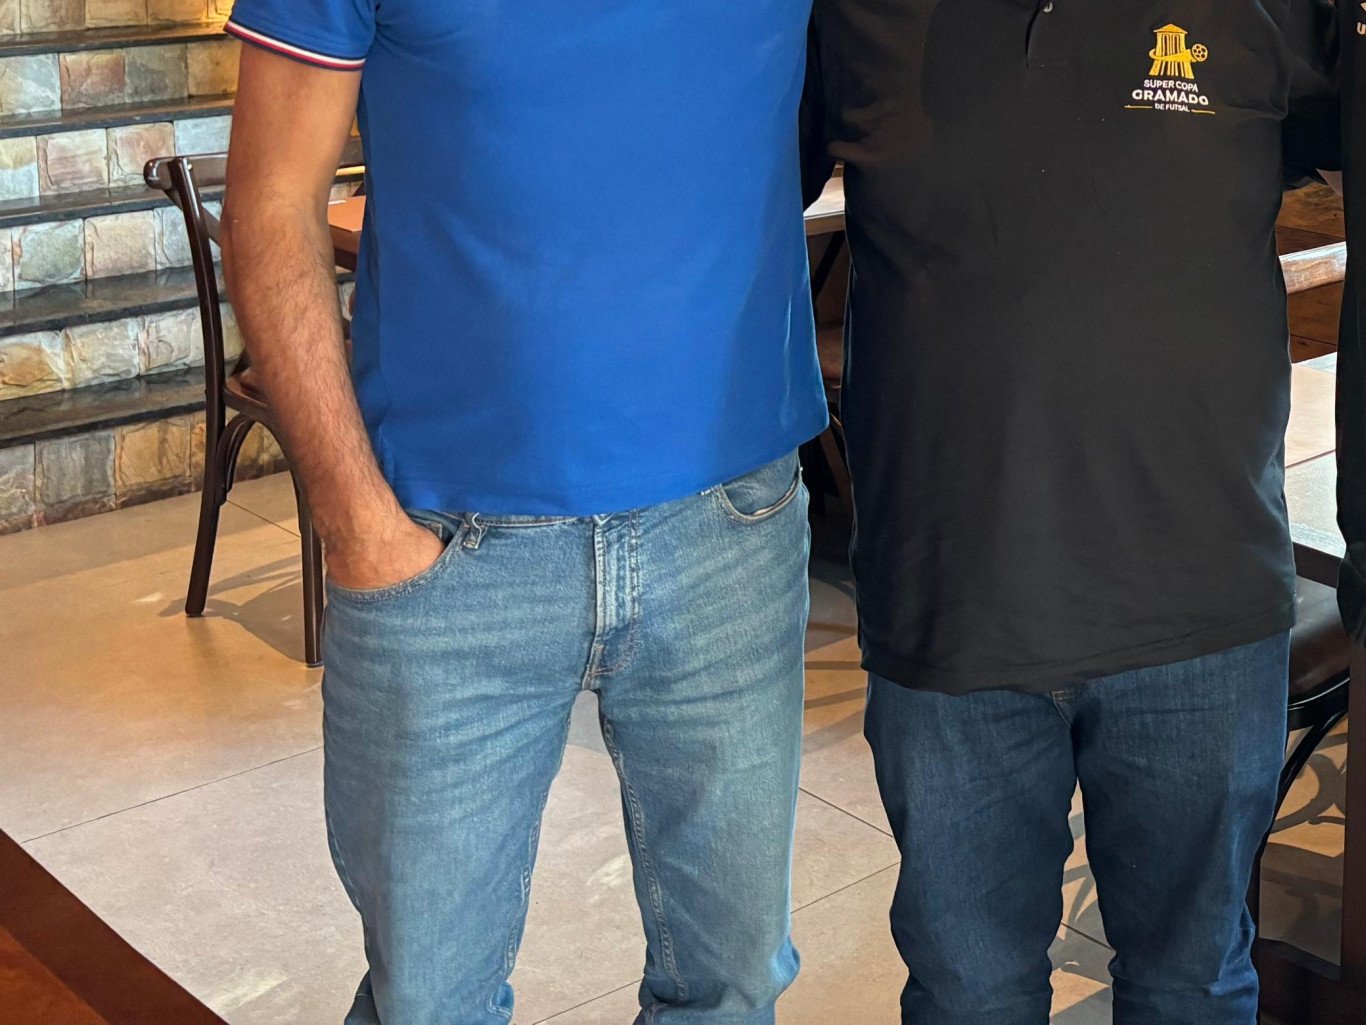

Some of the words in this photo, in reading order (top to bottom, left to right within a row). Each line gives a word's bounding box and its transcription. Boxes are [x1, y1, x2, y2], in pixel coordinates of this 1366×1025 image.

[1143, 79, 1175, 89] SUPER
[1175, 81, 1199, 93] COPA
[1131, 89, 1209, 106] GRAMADO
[1165, 103, 1191, 113] FUTSAL
